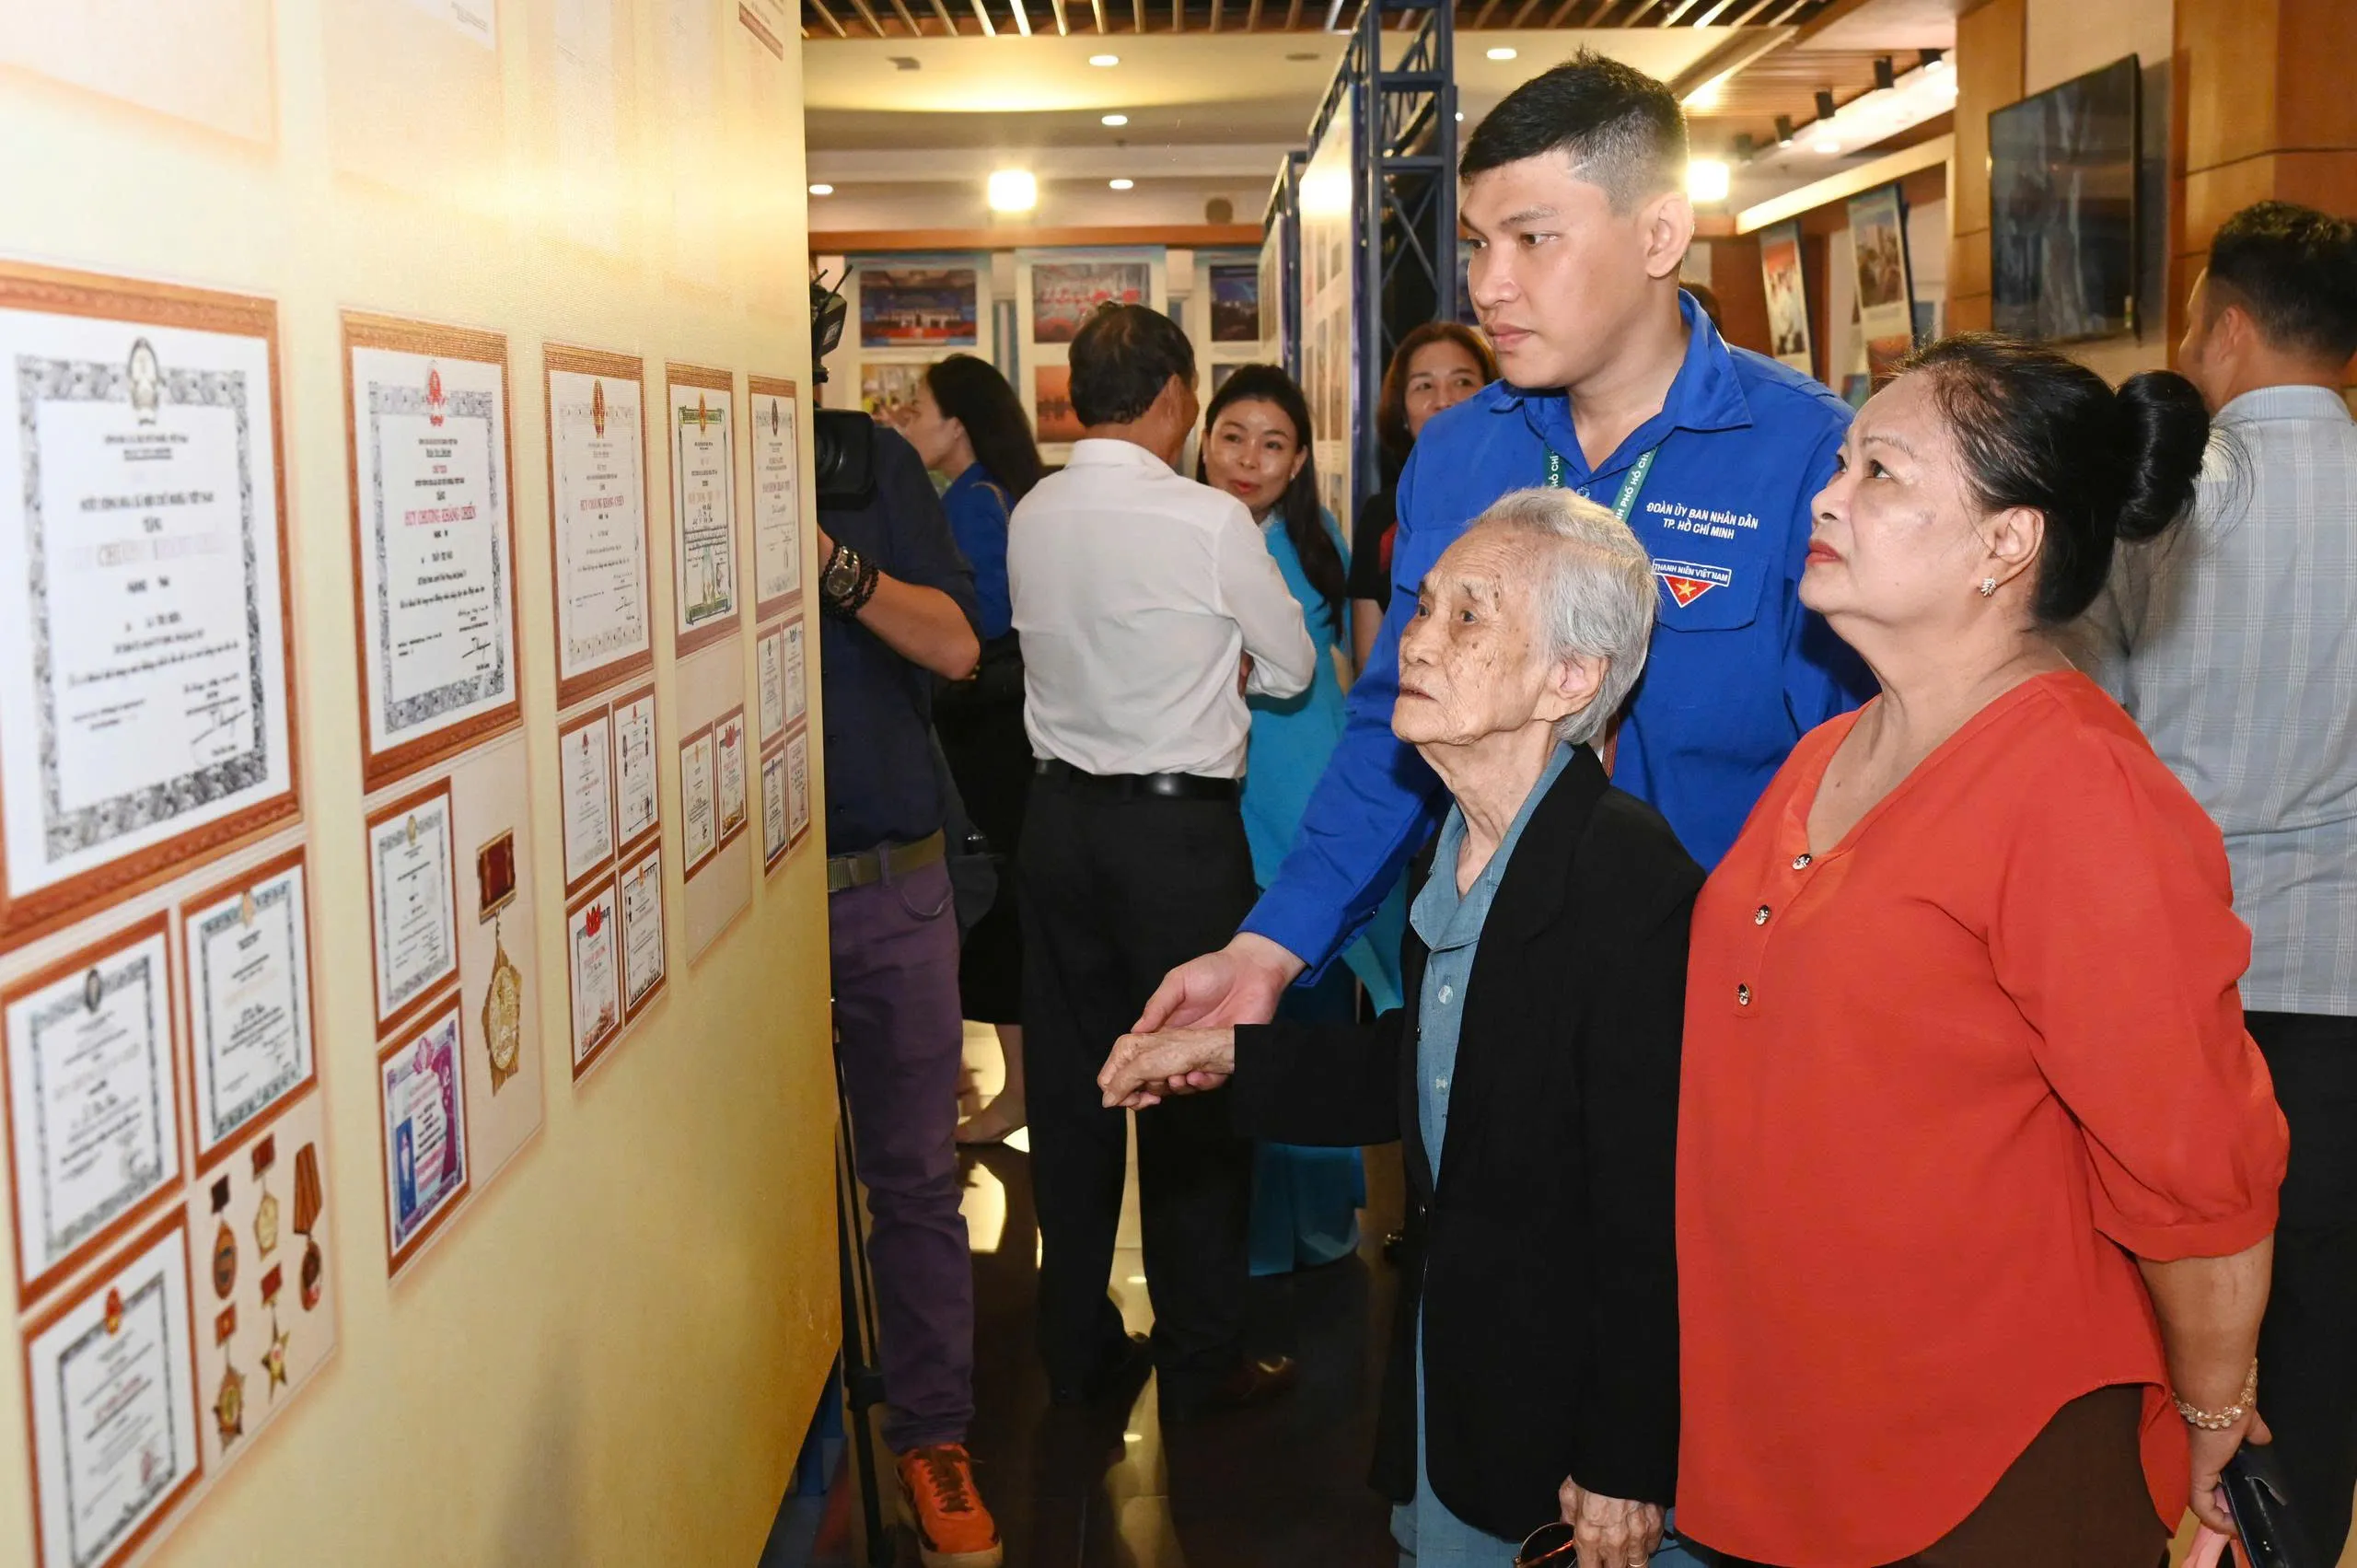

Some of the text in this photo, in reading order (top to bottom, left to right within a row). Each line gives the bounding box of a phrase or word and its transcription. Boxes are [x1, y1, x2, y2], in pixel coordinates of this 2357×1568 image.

[1550, 455, 1559, 471] CHÍ
[1620, 486, 1634, 507] PHỐ
[1646, 500, 1759, 529] ĐOÀN ỦY BAN NHÂN DÂN
[1663, 517, 1676, 529] TP.
[1692, 522, 1711, 535] CHÍ
[1710, 528, 1735, 540] MINH
[1655, 563, 1728, 582] THANH NIÊN VIỆT NAM
